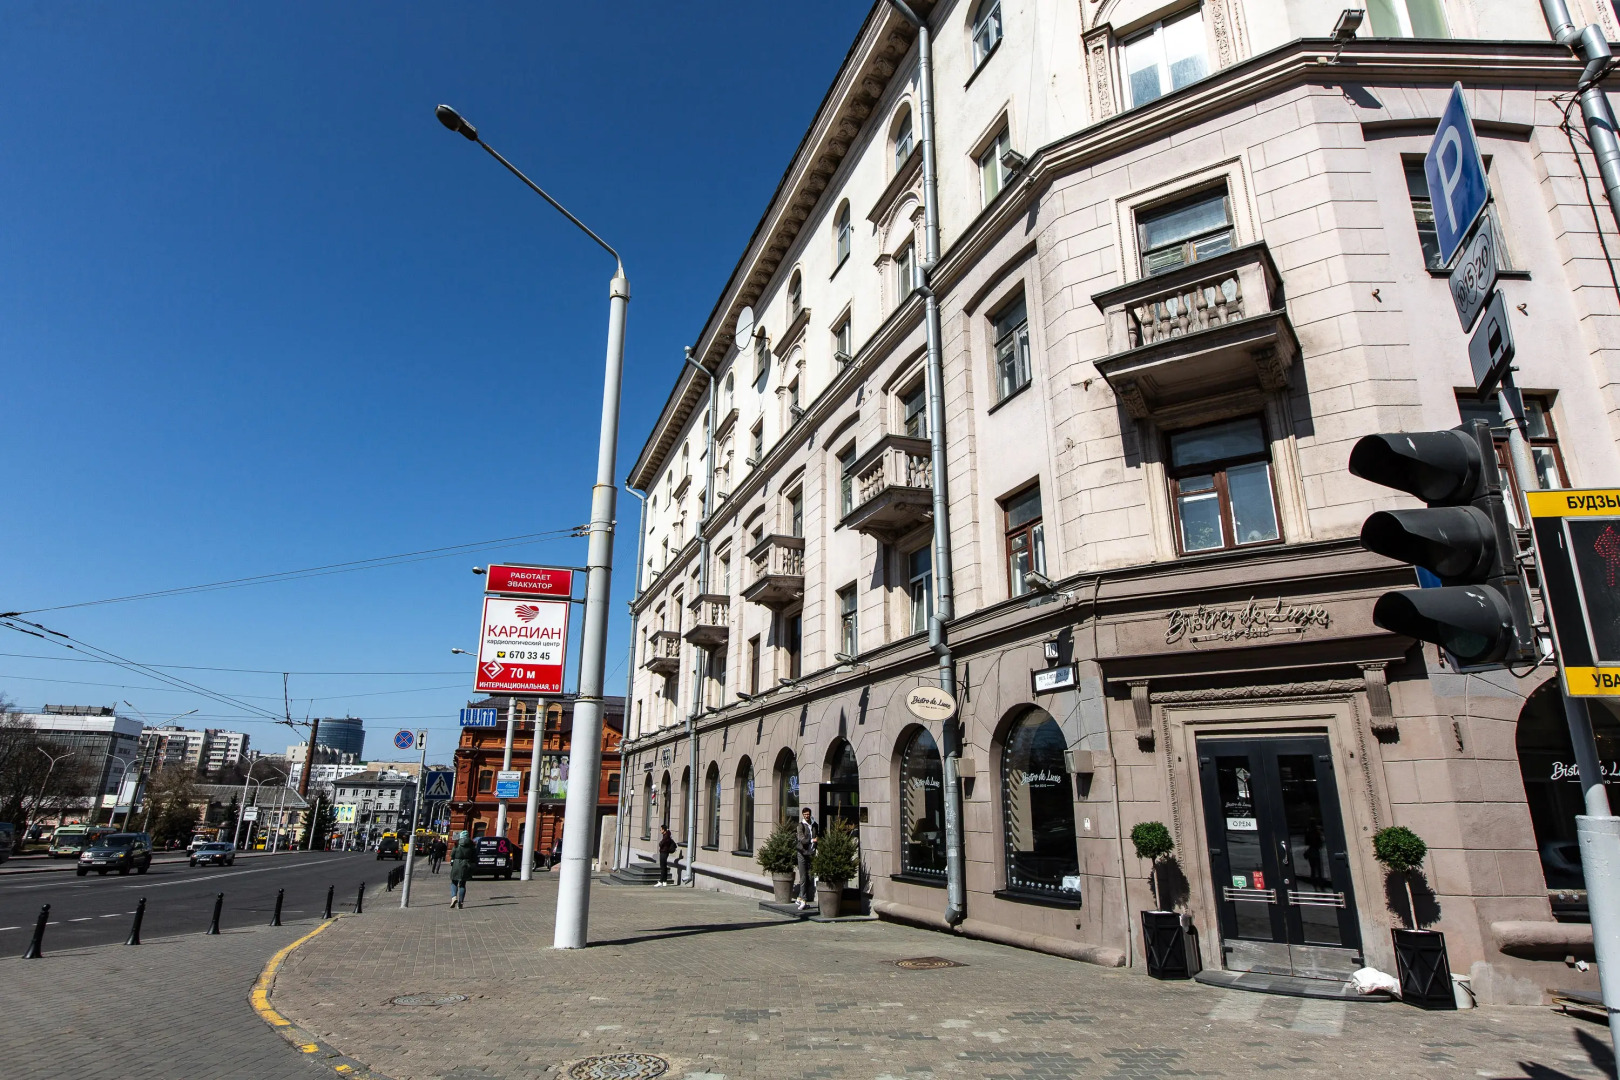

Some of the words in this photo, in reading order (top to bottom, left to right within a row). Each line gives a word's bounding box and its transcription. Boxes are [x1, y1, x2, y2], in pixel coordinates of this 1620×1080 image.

[1436, 125, 1462, 235] P
[1475, 245, 1489, 280] 20
[510, 572, 551, 580] РАБОТАЕТ
[508, 580, 552, 590] ЭВАКУАТОР
[488, 624, 561, 640] КАРДИАН
[509, 650, 525, 659] 670
[527, 651, 538, 660] 33
[539, 652, 550, 661] 45
[1046, 643, 1057, 657] 10
[510, 667, 524, 679] 70
[479, 681, 551, 690] ИНТЕРНАЦИОНАЛЬНАЯ,
[910, 695, 930, 705] Bistro
[929, 697, 937, 706] de
[1550, 761, 1580, 780] Bist
